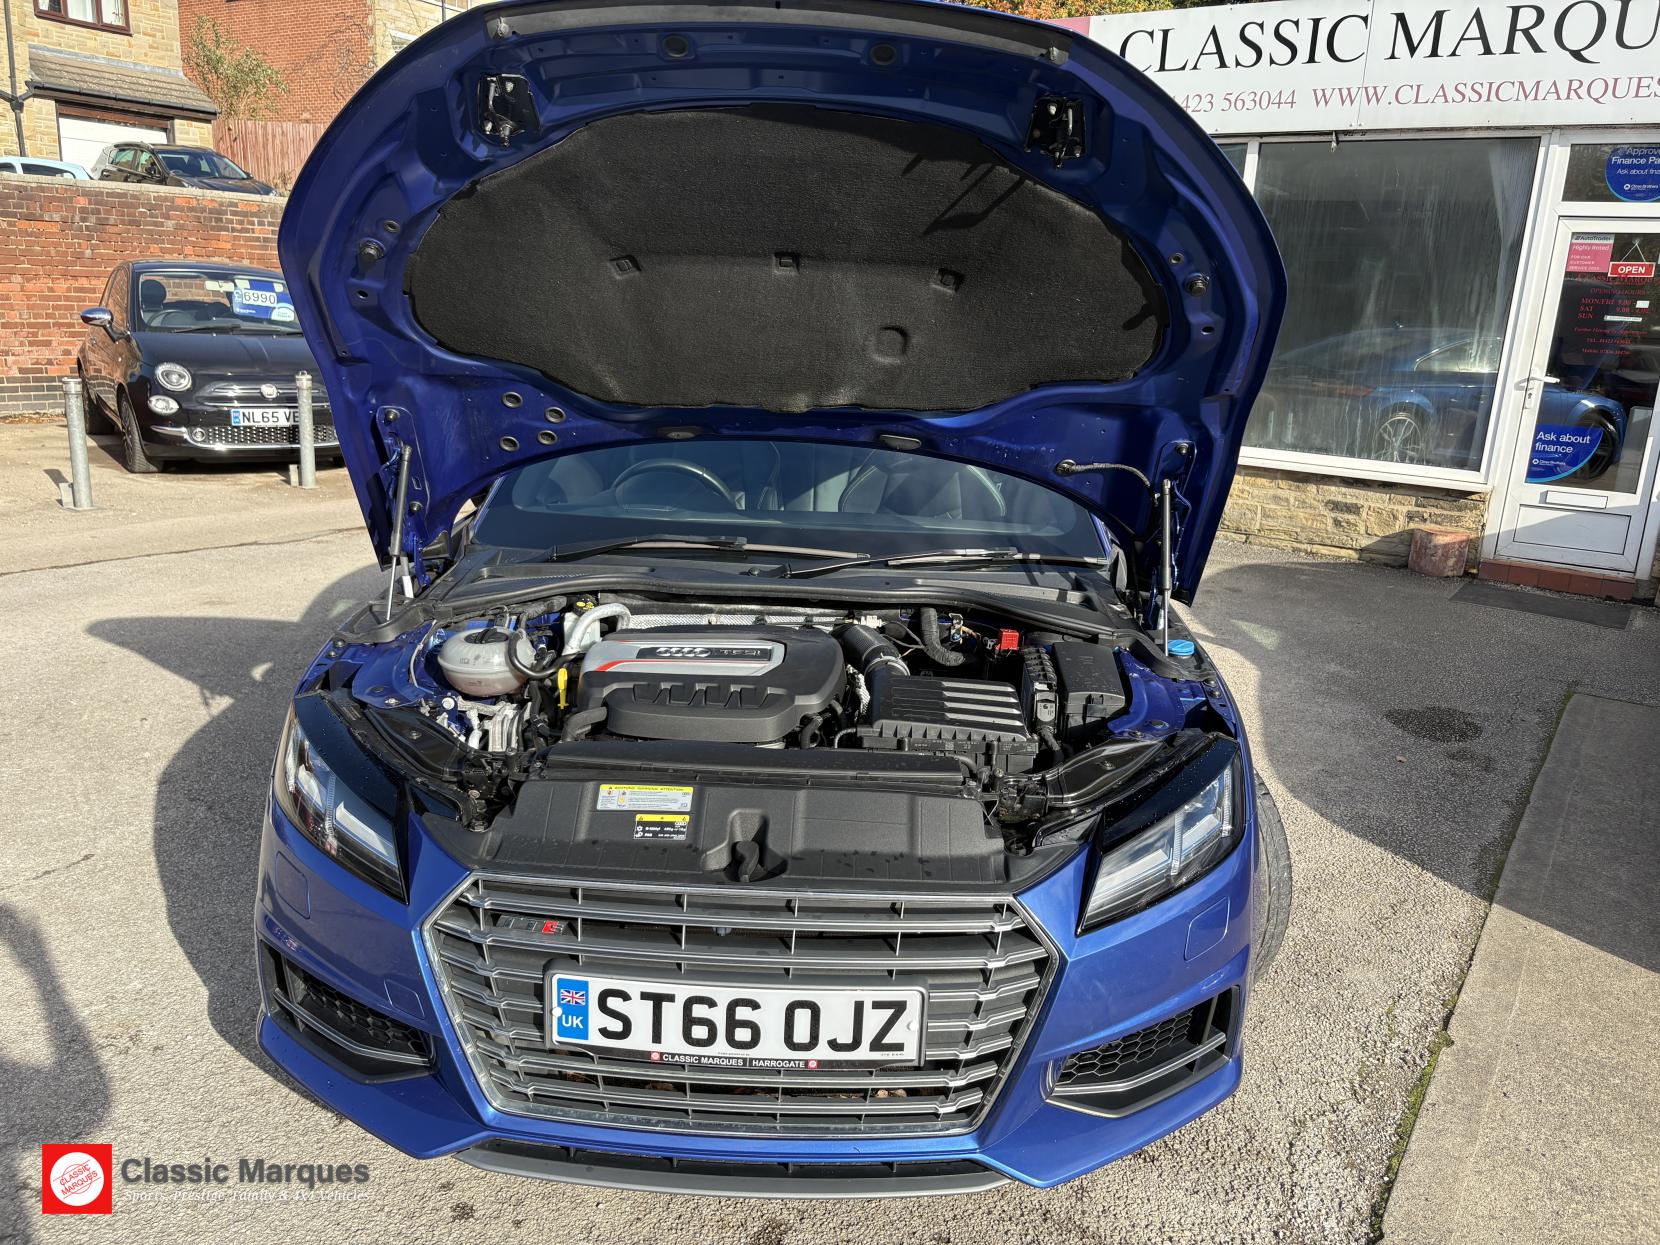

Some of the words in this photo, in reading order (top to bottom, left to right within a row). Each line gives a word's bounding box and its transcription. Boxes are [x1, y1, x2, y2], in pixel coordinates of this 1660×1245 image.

[1119, 14, 1369, 73] CLASSIC
[1384, 0, 1660, 64] MARQU
[1173, 93, 1214, 112] 423
[1221, 89, 1296, 112] 563044
[1611, 156, 1647, 165] Finance
[1617, 265, 1646, 274] OPEN
[242, 411, 279, 423] NL65
[1536, 431, 1557, 441] Ask
[1559, 433, 1590, 444] about
[1535, 442, 1573, 453] finance
[562, 1014, 584, 1029] UK
[597, 988, 762, 1050] ST66
[783, 1000, 907, 1052] OJZ
[662, 1054, 699, 1064] CLASSIC
[700, 1056, 744, 1066] MARQUES
[752, 1059, 805, 1068] HARROGATE
